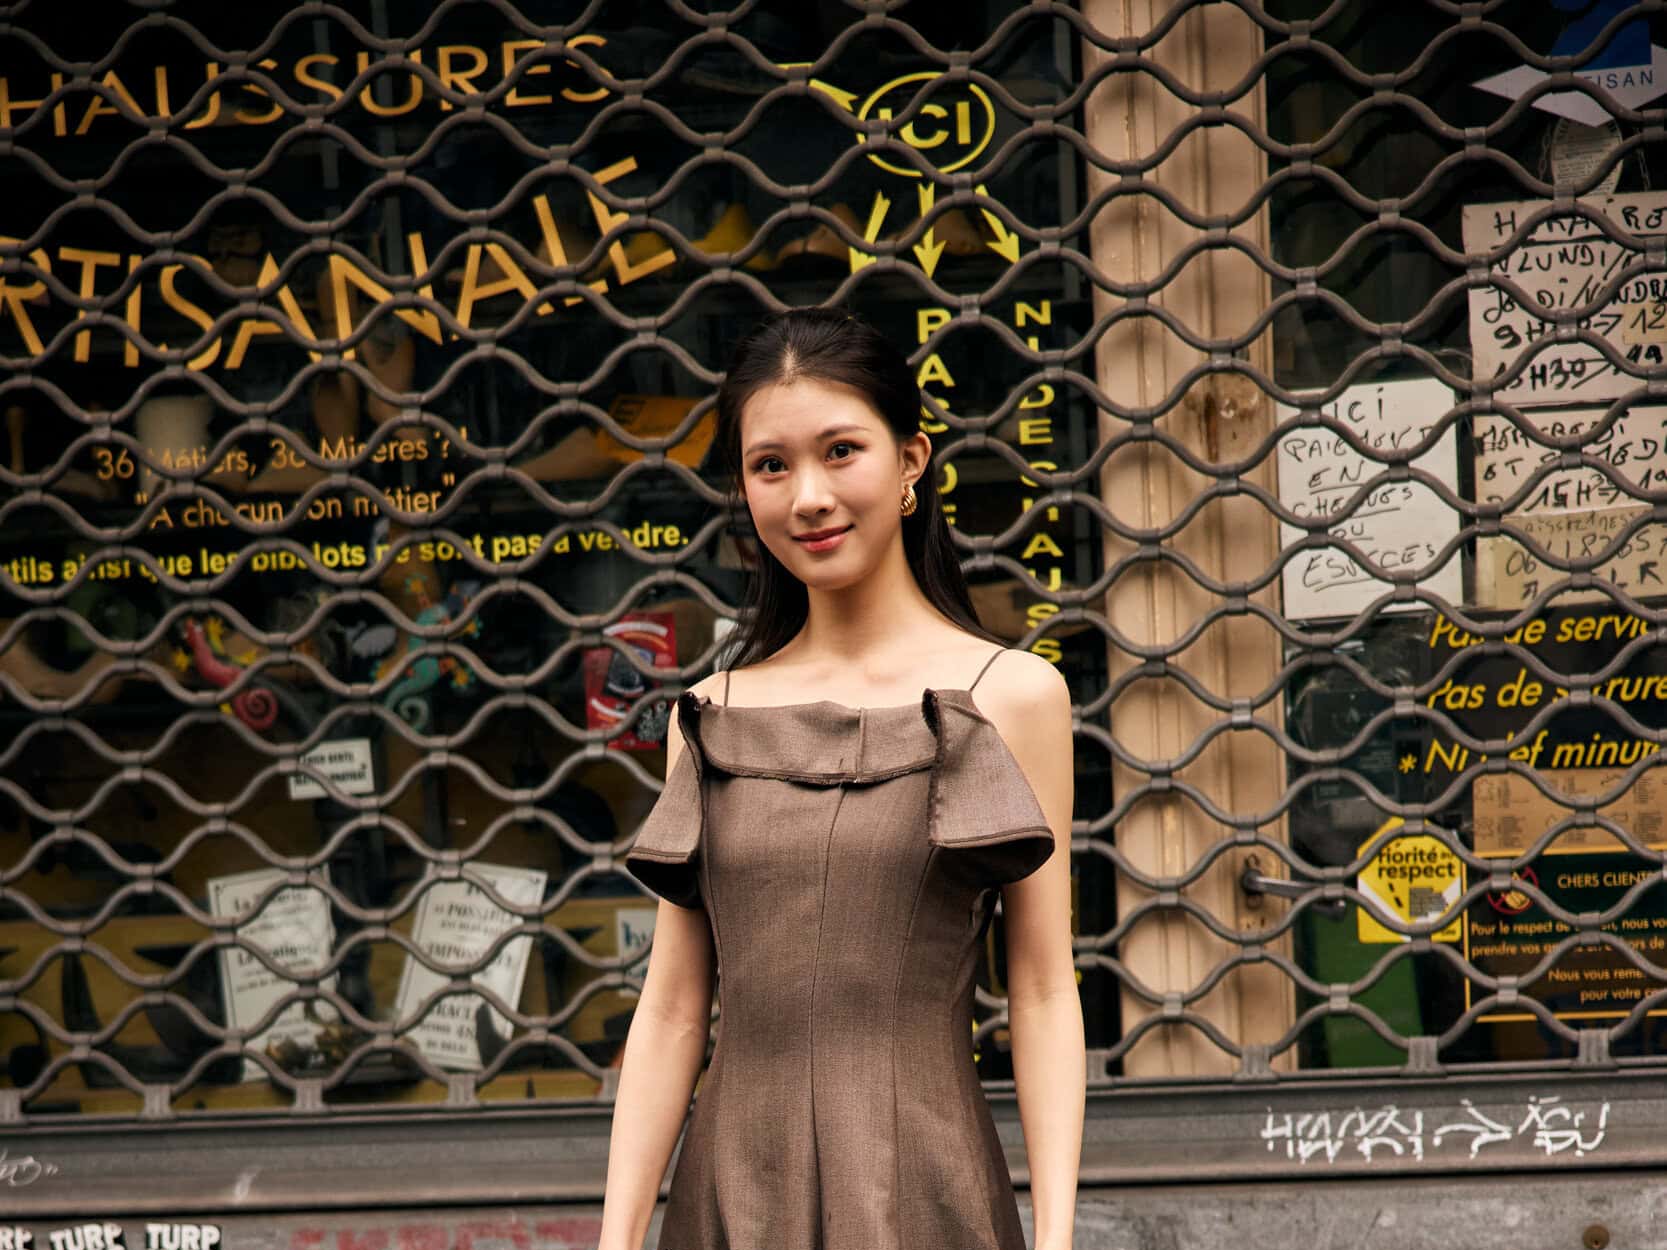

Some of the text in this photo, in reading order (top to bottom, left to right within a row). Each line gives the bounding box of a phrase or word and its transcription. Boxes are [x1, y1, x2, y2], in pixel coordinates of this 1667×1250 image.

[95, 446, 135, 480] 36
[418, 532, 485, 561] sot
[492, 533, 543, 564] pas
[1496, 667, 1543, 708] de
[1378, 862, 1456, 884] respect
[1555, 870, 1650, 889] CHERS CLIENT
[1548, 967, 1580, 983] Nous
[1583, 967, 1610, 981] vous
[1580, 988, 1608, 1006] pour
[145, 1223, 220, 1250] TURP
